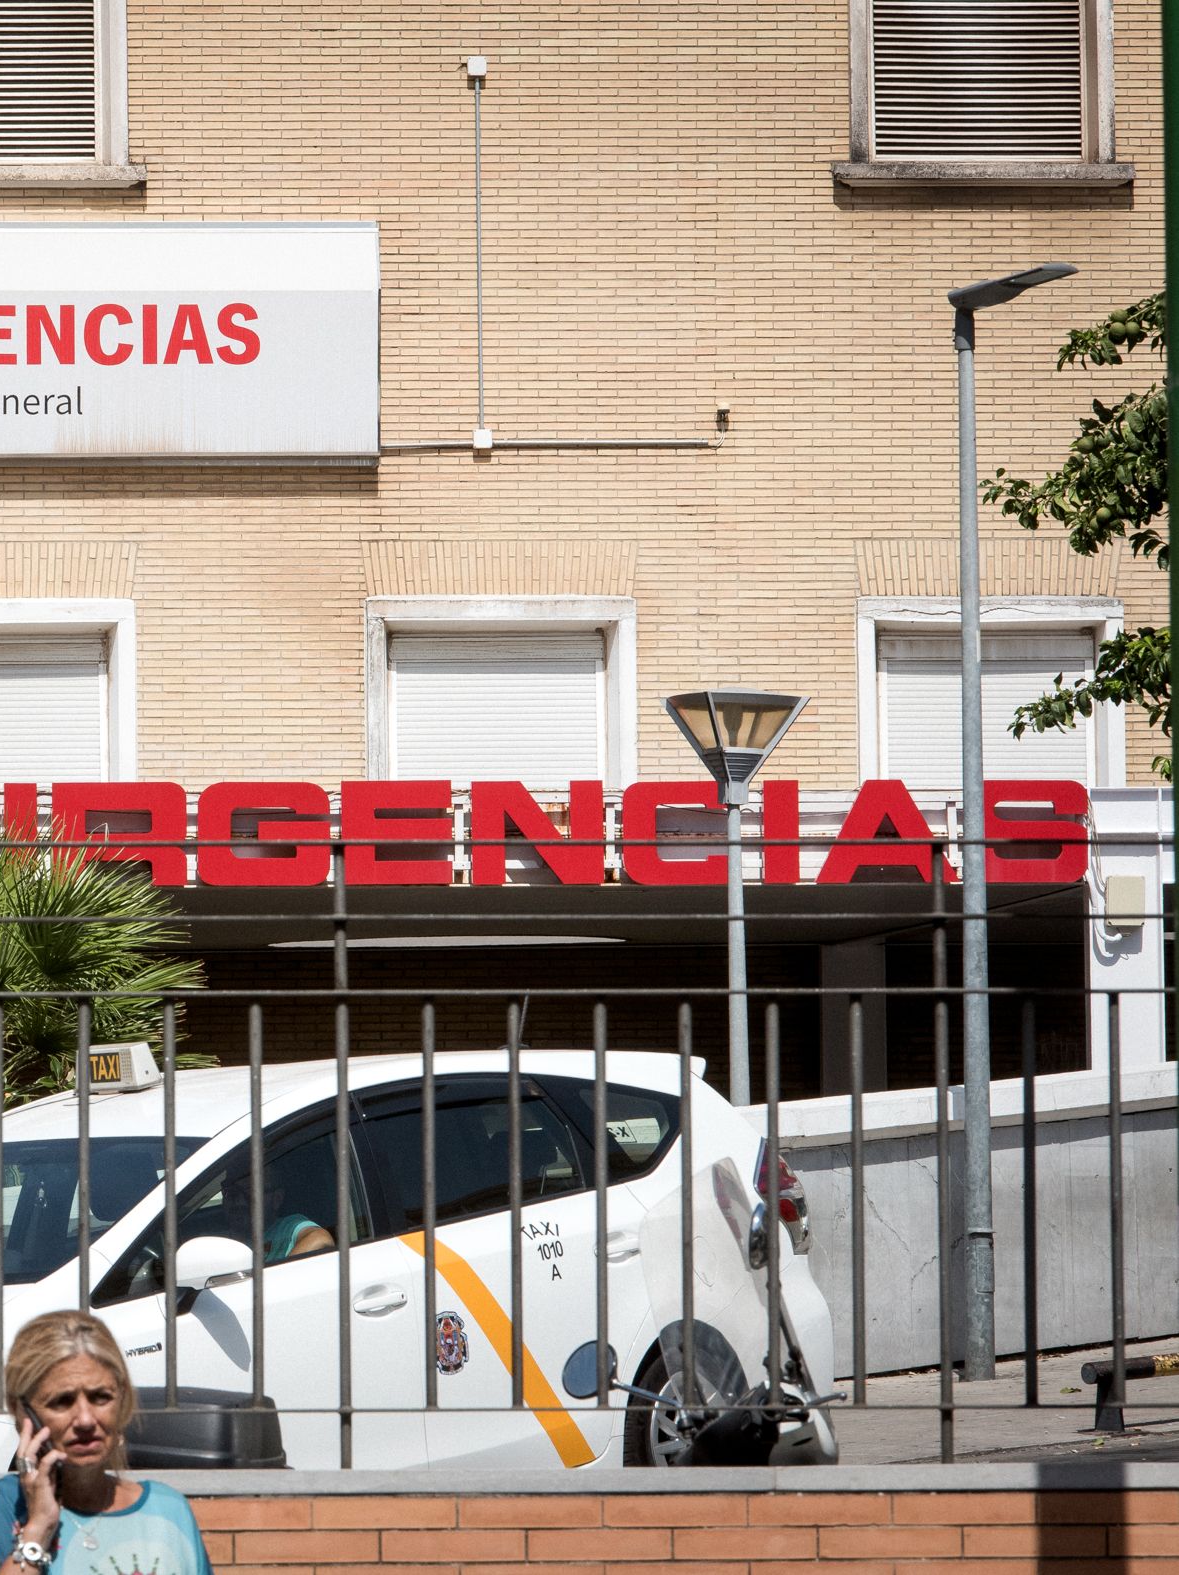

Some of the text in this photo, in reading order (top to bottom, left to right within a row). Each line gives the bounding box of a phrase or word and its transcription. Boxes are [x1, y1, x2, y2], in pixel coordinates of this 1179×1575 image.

[89, 1055, 120, 1081] TAXI
[519, 1221, 560, 1240] TAXI
[537, 1240, 564, 1261] 1010
[551, 1263, 562, 1281] A
